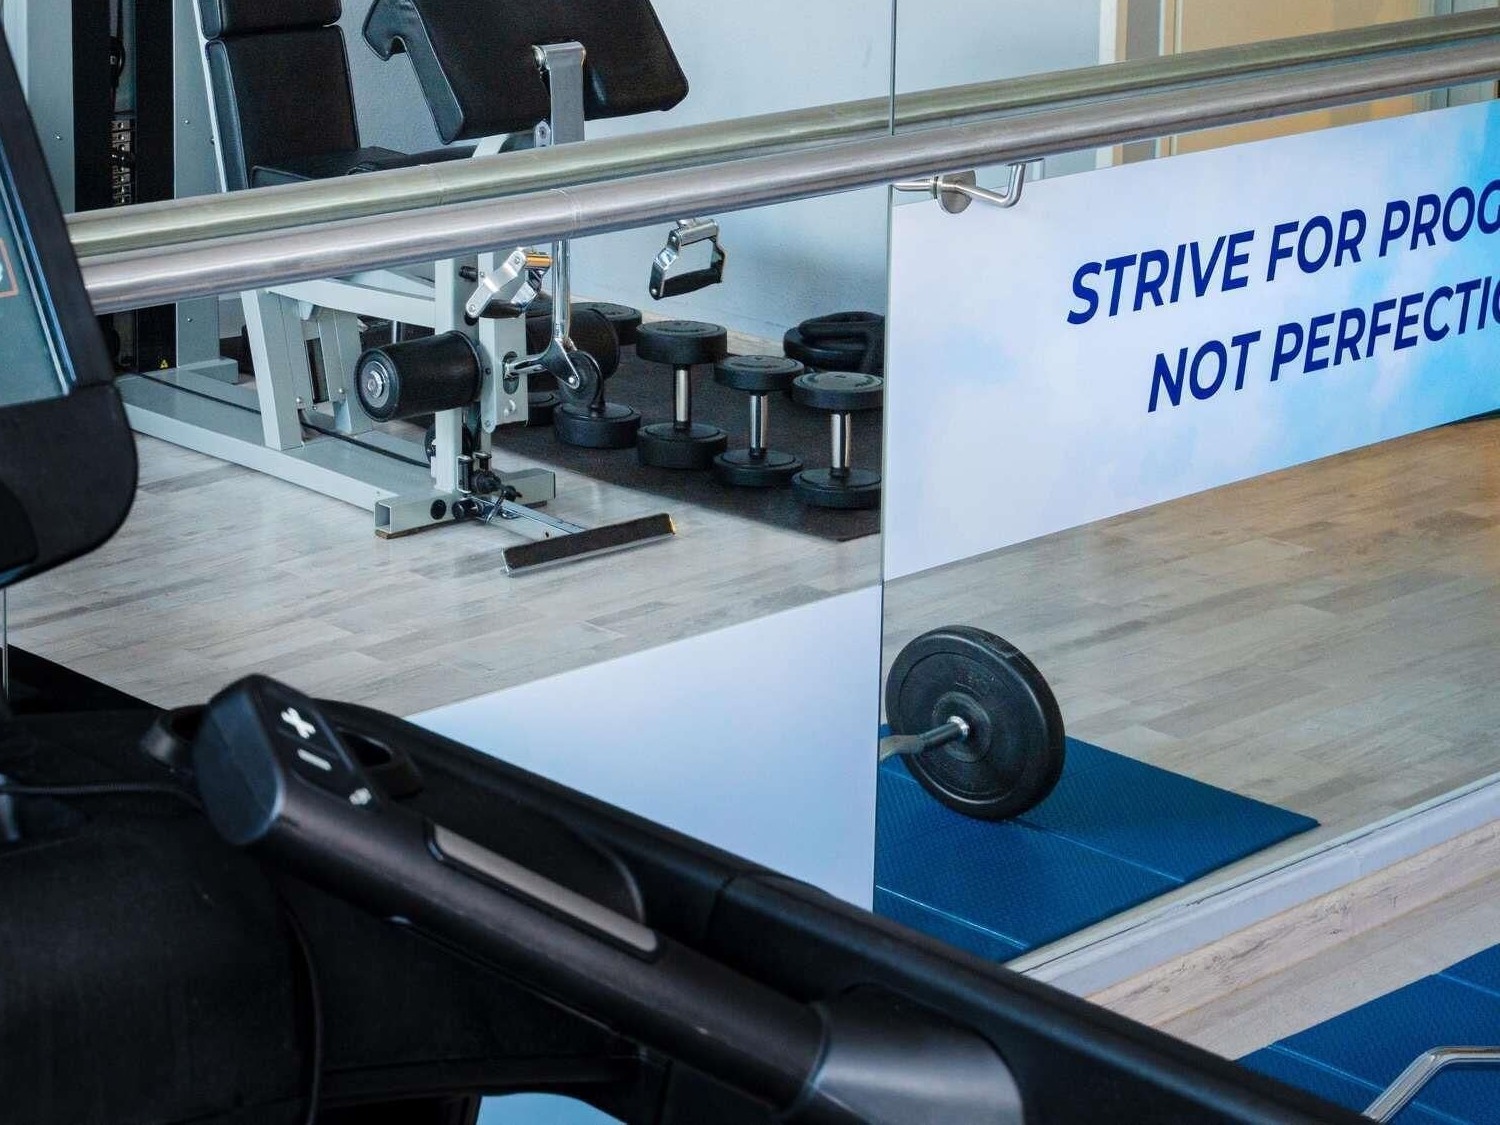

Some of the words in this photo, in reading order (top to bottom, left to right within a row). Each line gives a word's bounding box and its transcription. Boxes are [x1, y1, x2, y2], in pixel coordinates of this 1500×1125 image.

[1066, 230, 1255, 325] STRIVE
[1266, 208, 1367, 282] FOR
[1378, 179, 1500, 257] PROG
[1148, 330, 1262, 413] NOT
[1270, 275, 1500, 382] PERFECTI
